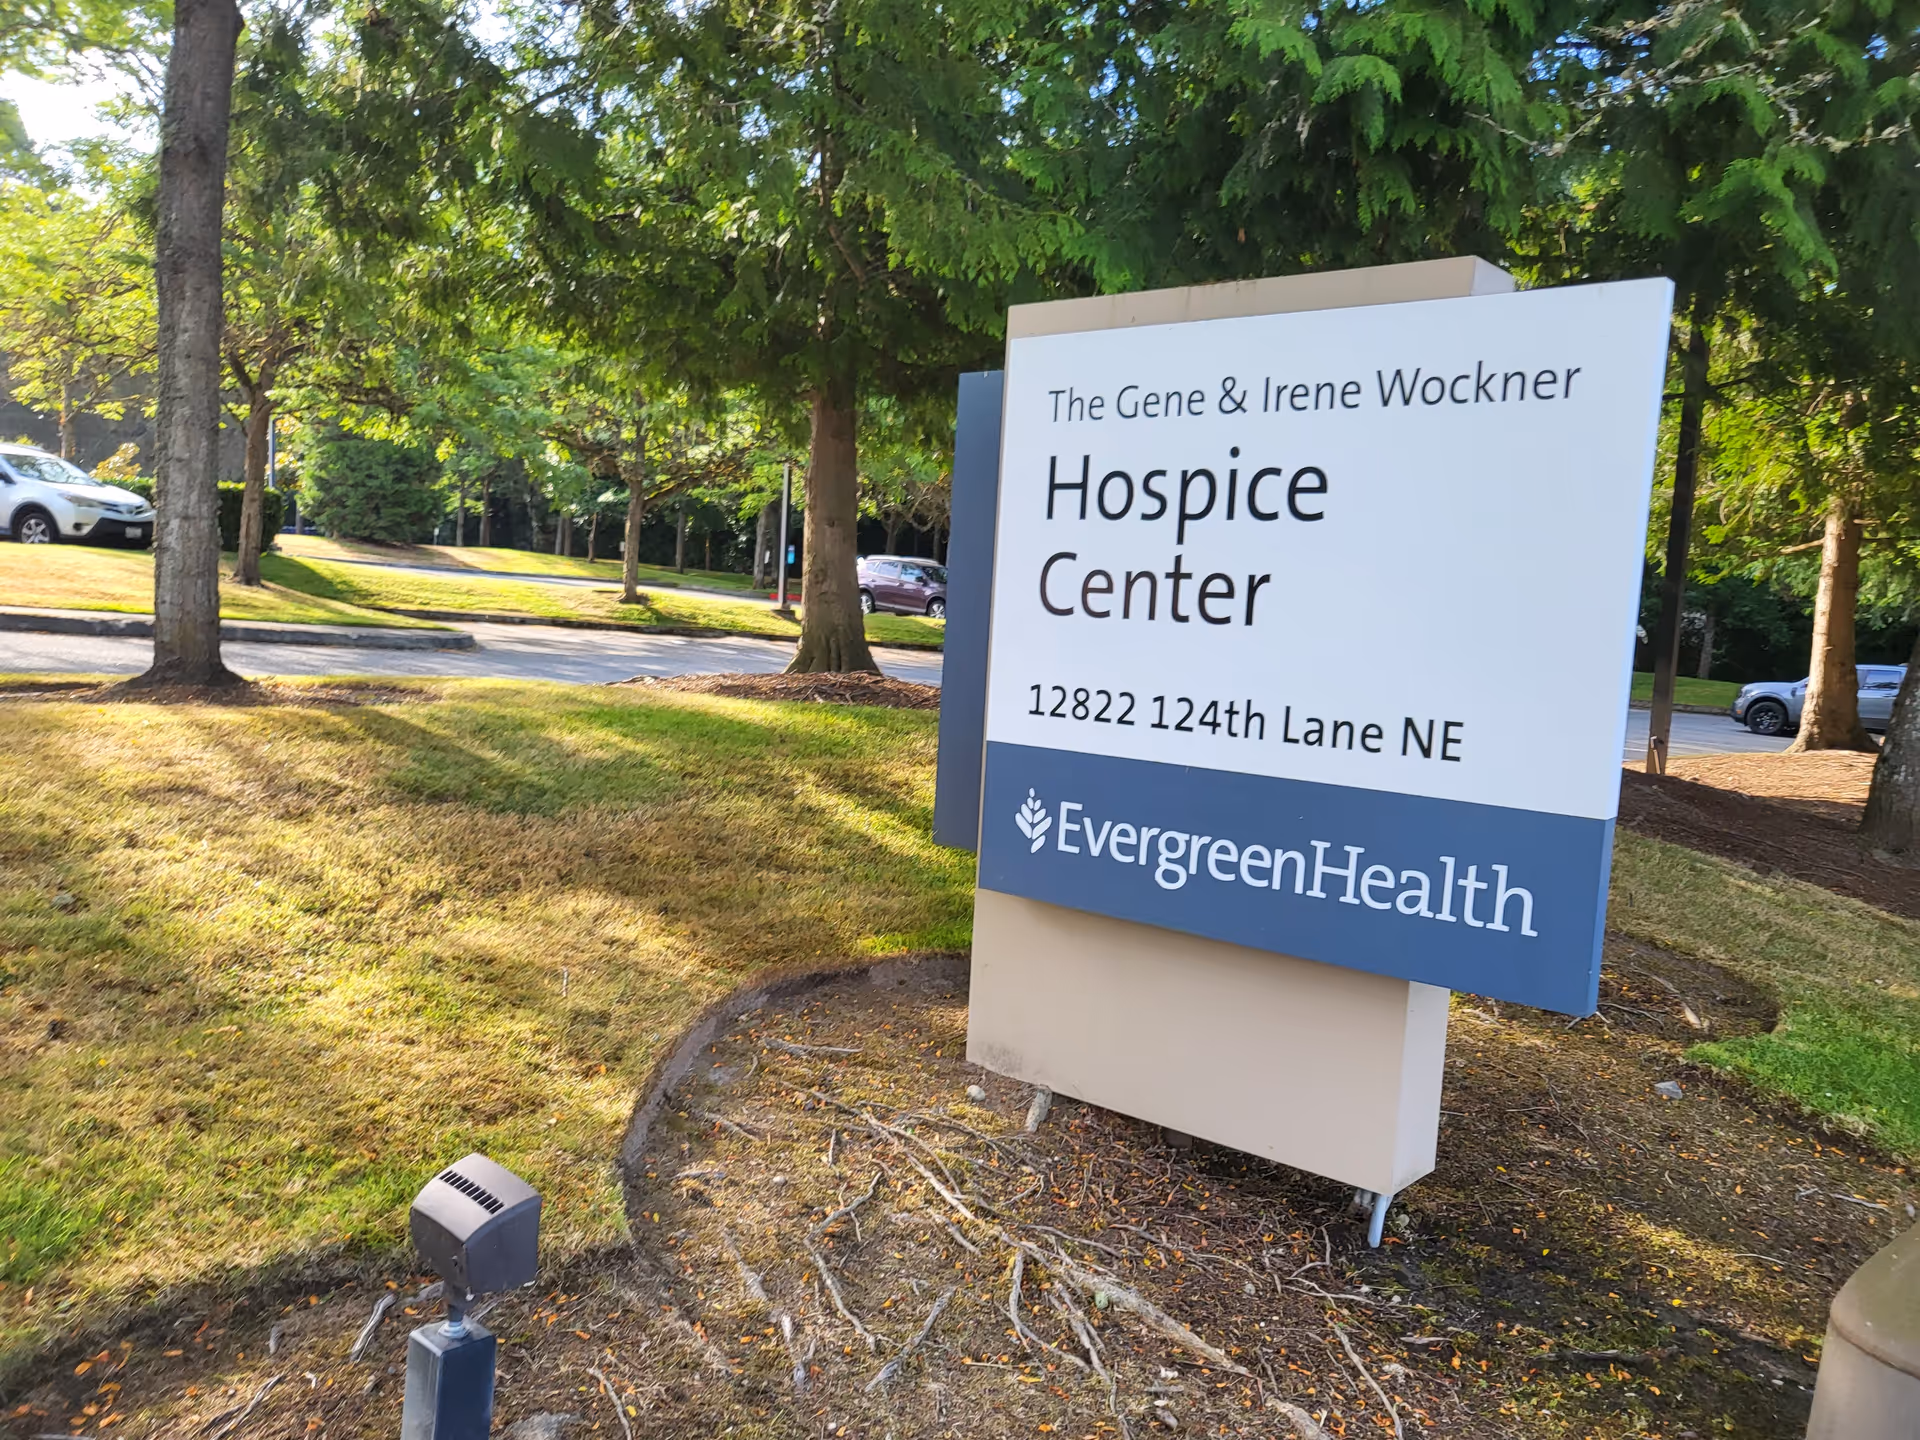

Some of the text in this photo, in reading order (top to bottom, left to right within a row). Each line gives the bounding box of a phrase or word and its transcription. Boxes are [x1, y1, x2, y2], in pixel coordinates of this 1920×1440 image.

[1048, 360, 1582, 422] The Gene & Irene Wockner
[1046, 446, 1328, 546] Hospice
[1039, 551, 1271, 627] Center
[1028, 684, 1464, 763] 12822 124th Lane NE
[1057, 801, 1538, 937] EvergreenHealth
